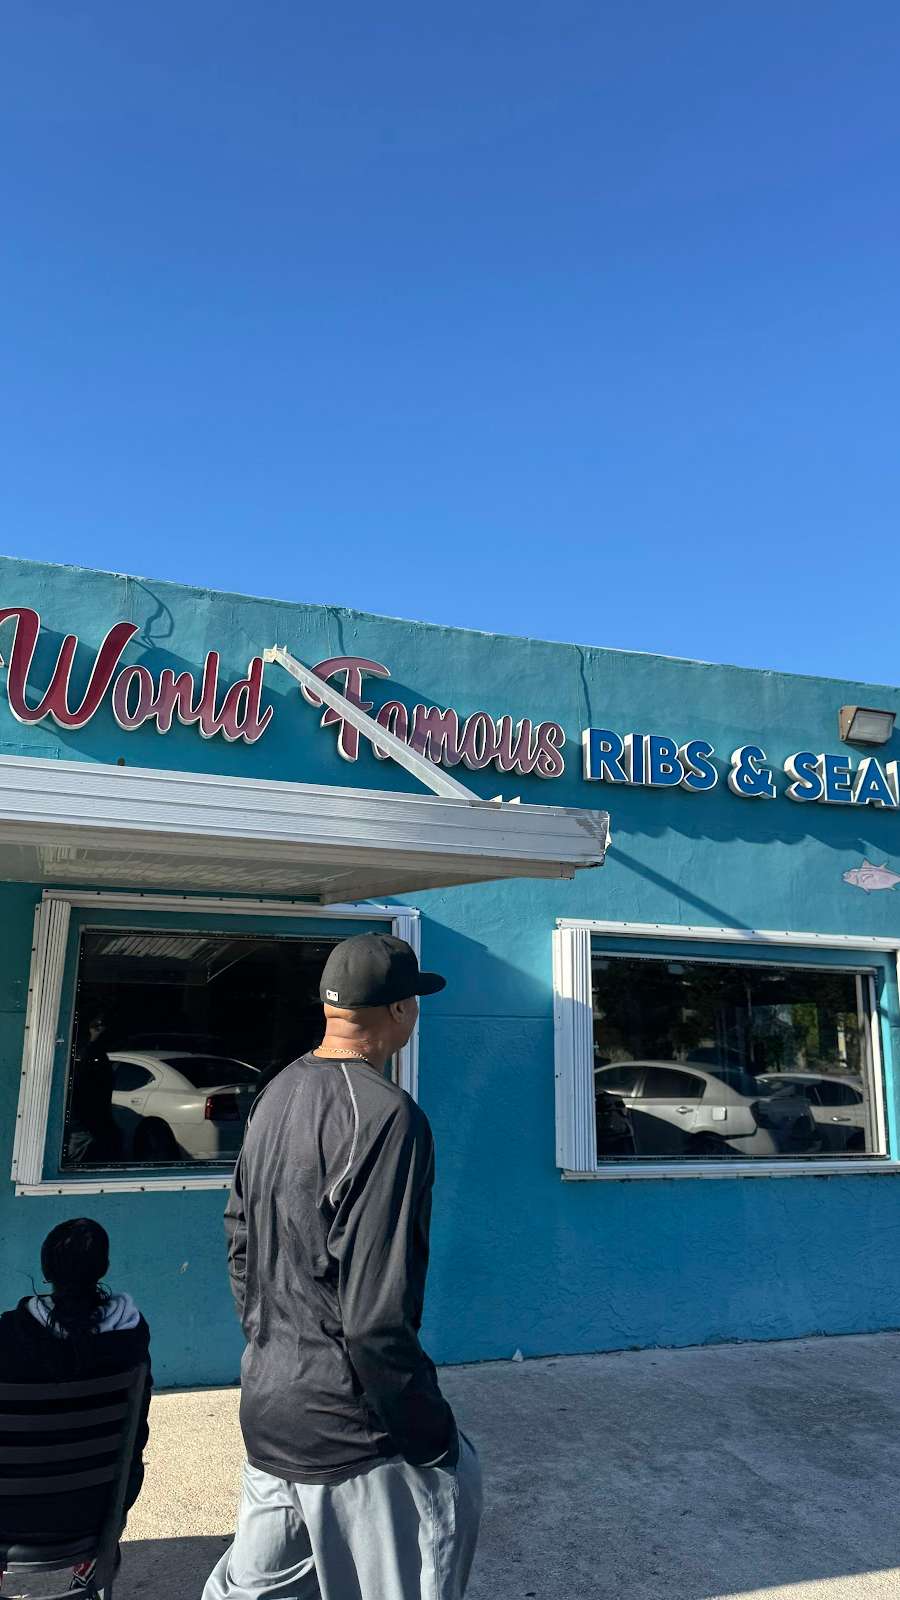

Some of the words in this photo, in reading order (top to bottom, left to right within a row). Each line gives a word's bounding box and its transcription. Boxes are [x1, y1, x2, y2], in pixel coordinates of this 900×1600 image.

[0, 606, 274, 745] World
[301, 655, 566, 779] Famous
[582, 728, 719, 792] RIBS
[728, 744, 777, 799] &
[784, 751, 900, 809] SEA
